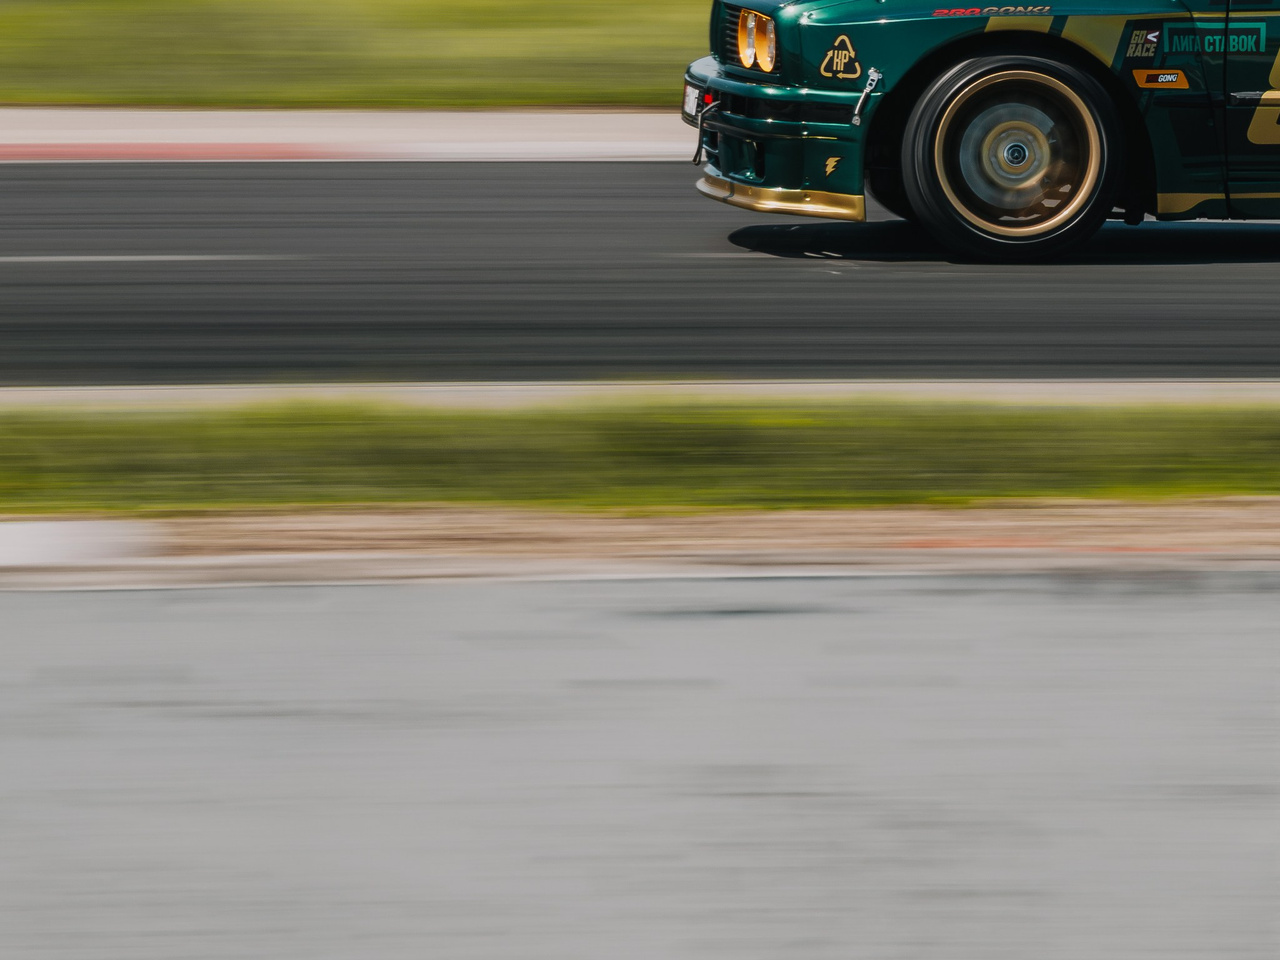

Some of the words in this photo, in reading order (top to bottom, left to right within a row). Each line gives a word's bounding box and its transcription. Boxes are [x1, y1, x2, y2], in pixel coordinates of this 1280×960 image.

[1131, 30, 1147, 44] GO
[1172, 35, 1201, 52] ЛИГА
[1204, 35, 1257, 52] СТАВОК
[1126, 43, 1157, 57] RACE
